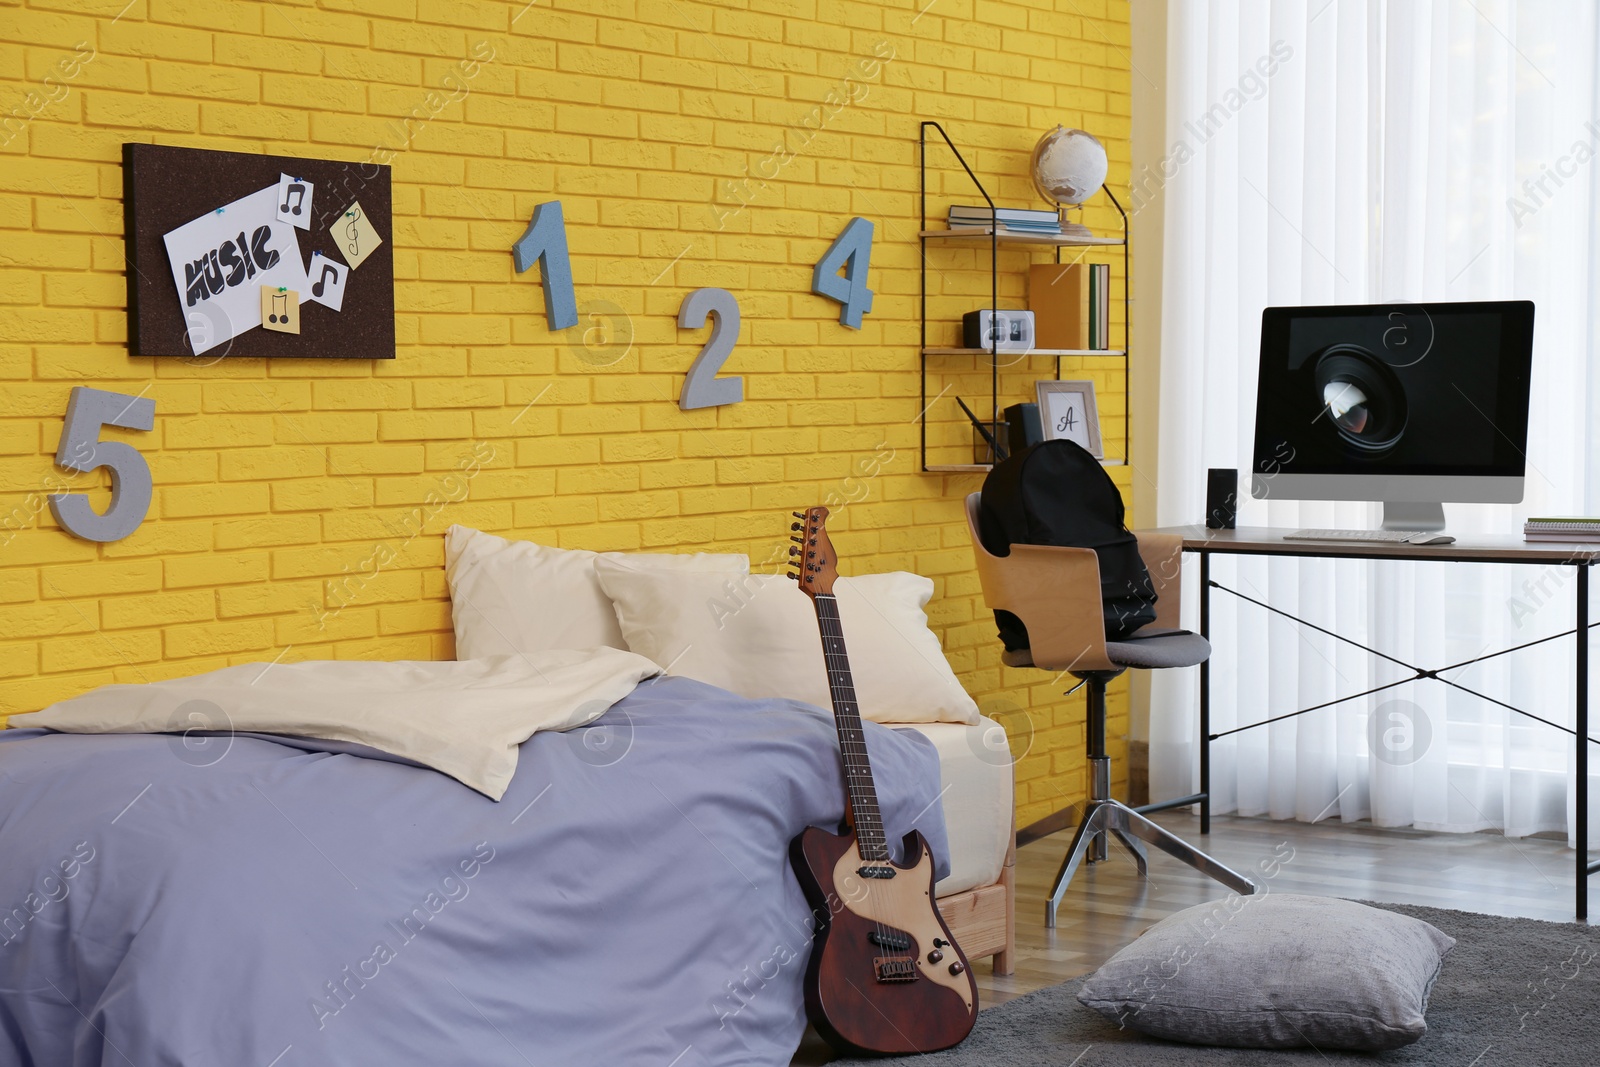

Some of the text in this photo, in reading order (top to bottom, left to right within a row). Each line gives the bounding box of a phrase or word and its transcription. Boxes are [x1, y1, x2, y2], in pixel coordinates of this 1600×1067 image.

[185, 225, 280, 307] MUSIC
[513, 201, 577, 330] 1
[812, 217, 874, 329] 4
[678, 288, 743, 410] 2
[48, 387, 155, 543] 5
[1057, 406, 1079, 432] A
